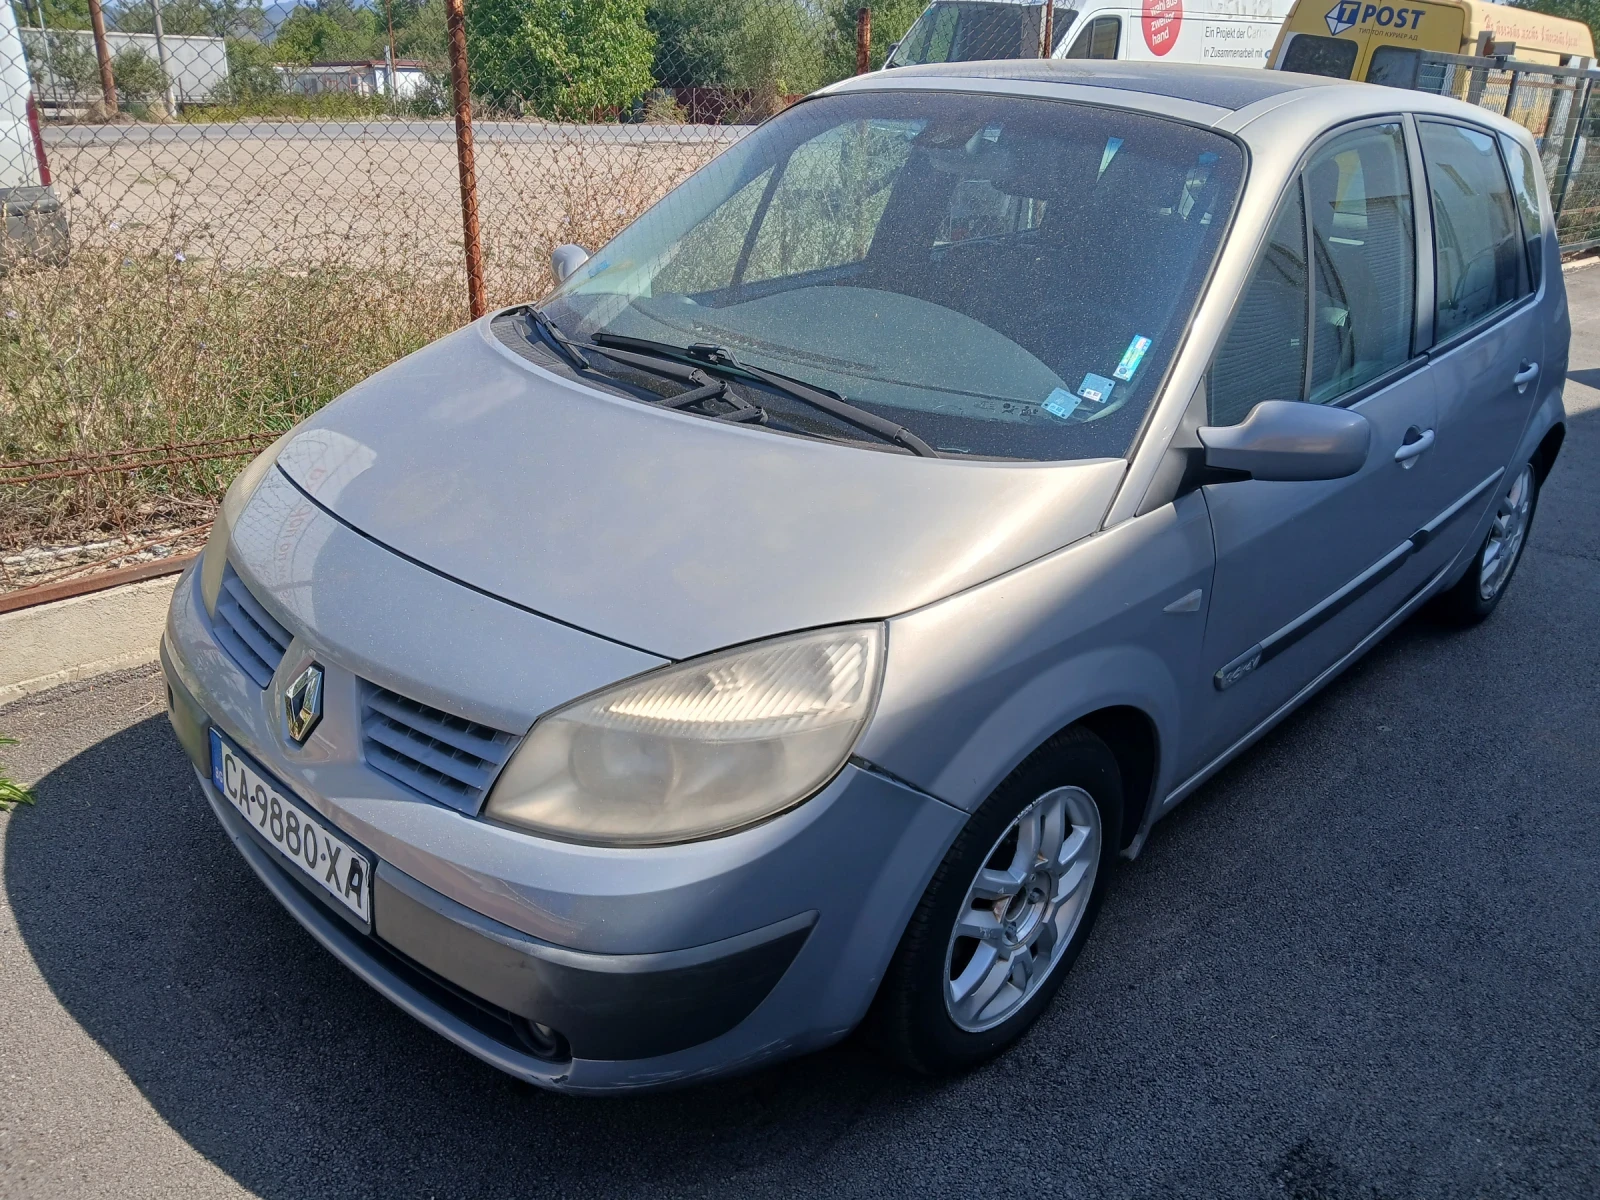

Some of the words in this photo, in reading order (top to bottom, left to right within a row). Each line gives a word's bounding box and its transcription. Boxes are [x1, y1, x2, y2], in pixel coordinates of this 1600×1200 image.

[1151, 12, 1175, 31] zweiter
[1361, 4, 1426, 30] POST
[1152, 26, 1170, 46] hand
[1205, 26, 1215, 38] Ein
[1216, 27, 1236, 41] Projekt
[1236, 28, 1246, 39] der
[1359, 27, 1371, 35] ТИП
[1371, 29, 1384, 37] ТОП
[1384, 31, 1408, 39] КУРИЕР
[1203, 46, 1210, 58] In
[1210, 46, 1255, 59] Zusammenarbeit
[1255, 48, 1263, 59] mit
[215, 766, 225, 784] BG
